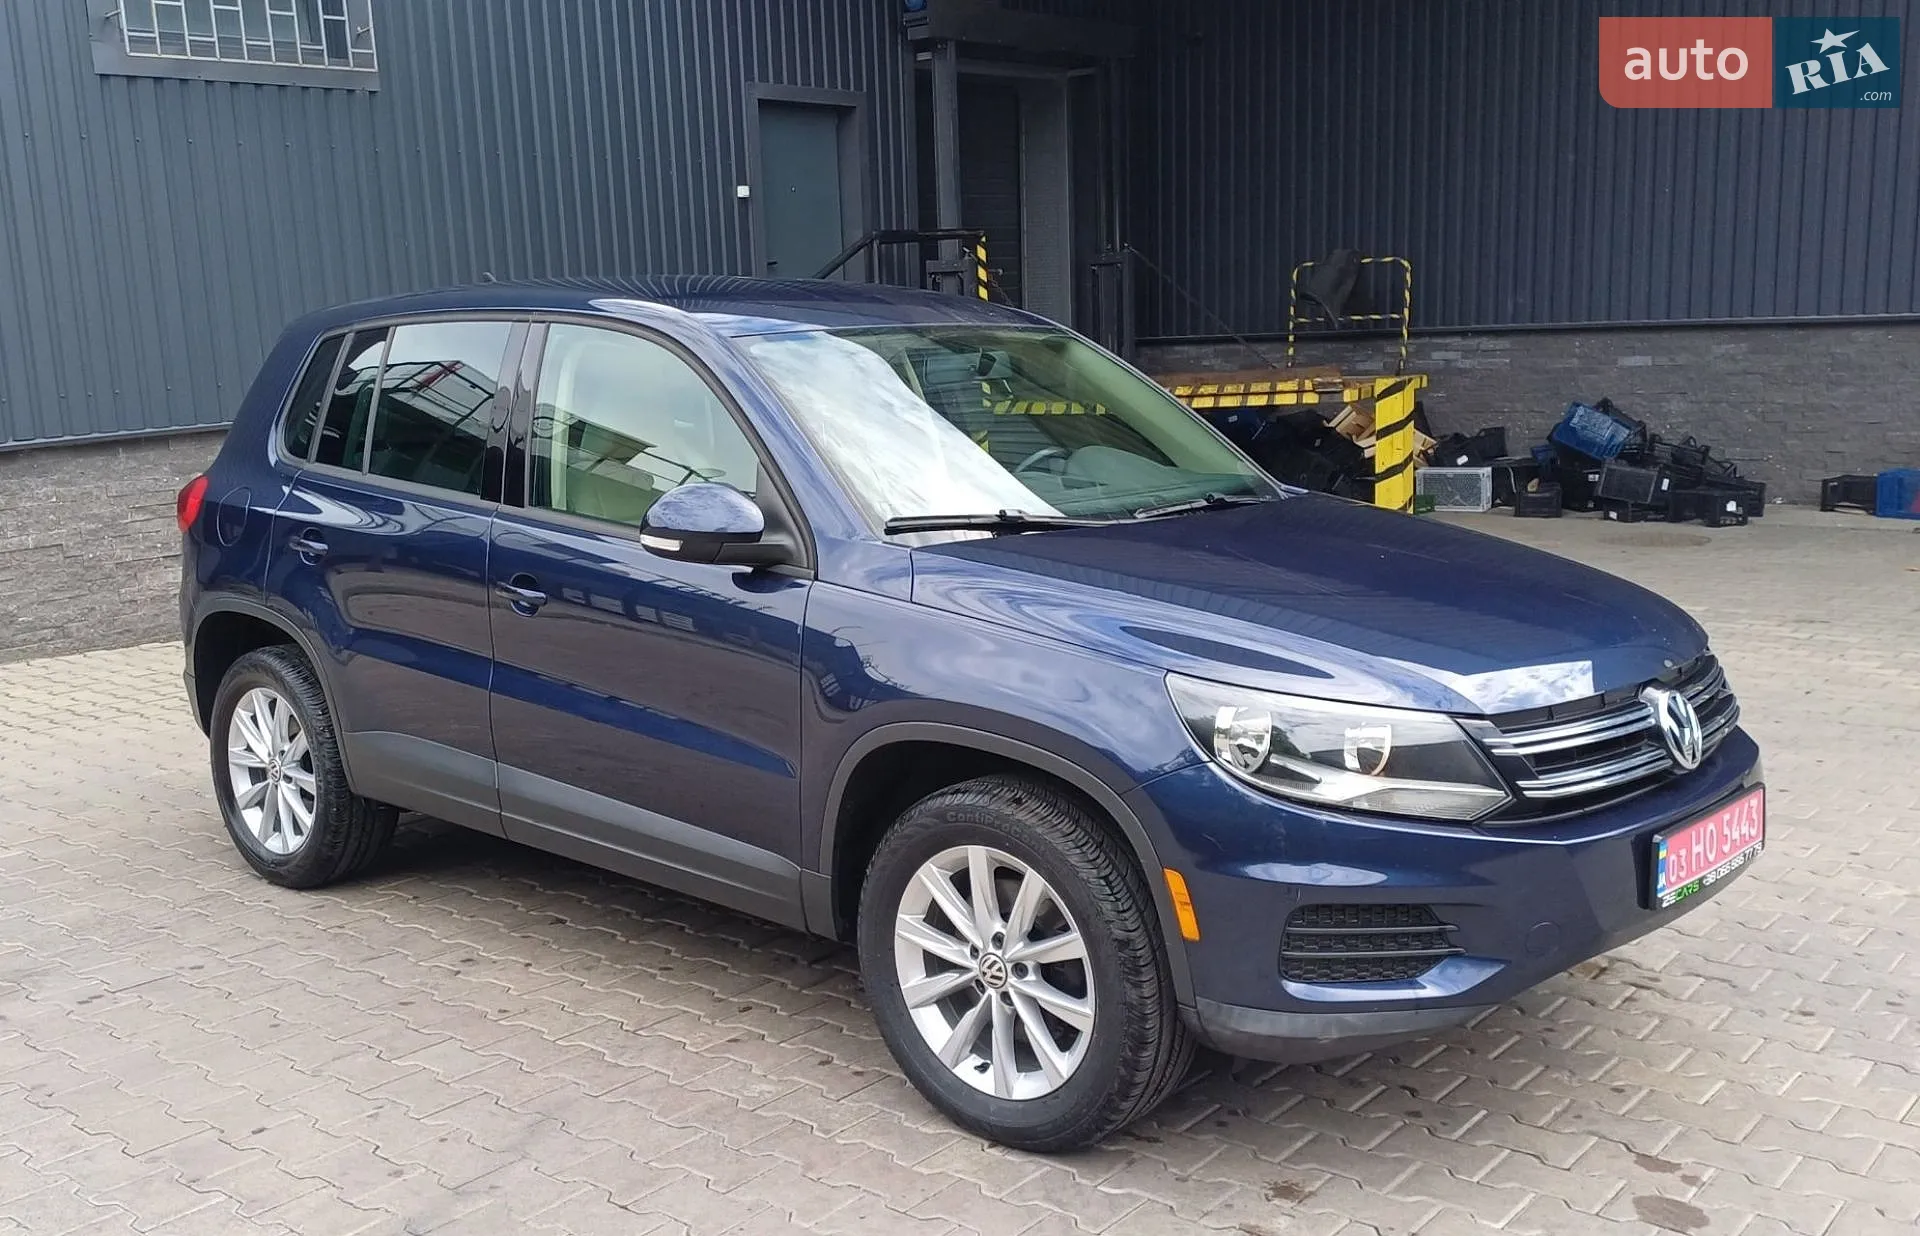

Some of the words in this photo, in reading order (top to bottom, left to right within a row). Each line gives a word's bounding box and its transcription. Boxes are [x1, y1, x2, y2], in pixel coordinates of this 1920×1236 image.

[1669, 847, 1688, 882] 03
[1691, 822, 1717, 873] HO
[1721, 798, 1759, 854] 5443
